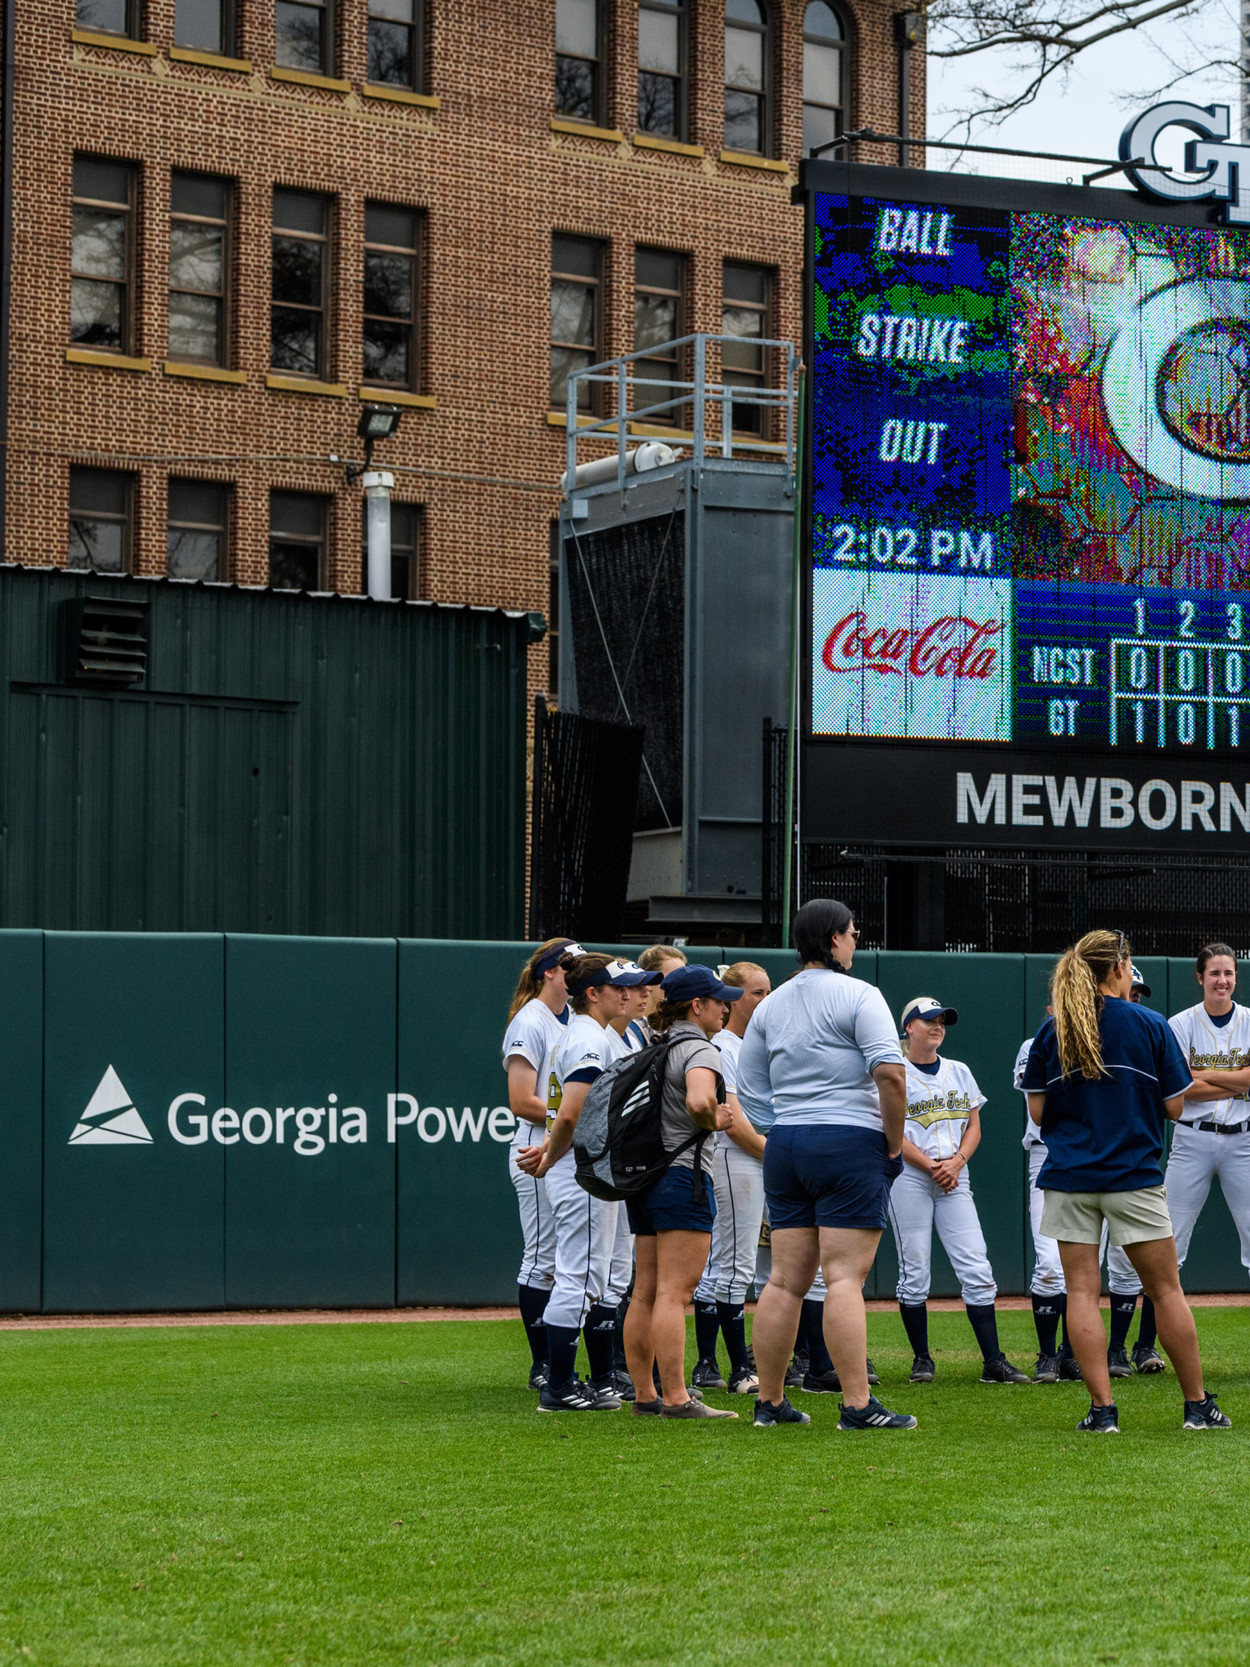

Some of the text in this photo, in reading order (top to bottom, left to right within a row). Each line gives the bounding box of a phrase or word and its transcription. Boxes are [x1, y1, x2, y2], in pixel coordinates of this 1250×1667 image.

[878, 208, 952, 256] BALL
[857, 313, 969, 364] STRIKE
[879, 418, 948, 465] OUT
[832, 524, 995, 570] 2:02 PM
[1134, 598, 1145, 636] 1
[1178, 600, 1195, 638] 2
[1226, 602, 1243, 640] 3
[822, 610, 1005, 680] Coca-Cola
[1033, 646, 1096, 686] NCST
[1130, 647, 1147, 690] 0
[1178, 649, 1195, 691] 0
[1225, 652, 1242, 694] 0
[1049, 699, 1080, 737] GT
[1131, 701, 1144, 743] 1
[1177, 703, 1195, 746] 0
[1227, 705, 1240, 748] 1
[580, 1052, 601, 1062] ACC
[167, 1092, 515, 1156] Georgia Powe
